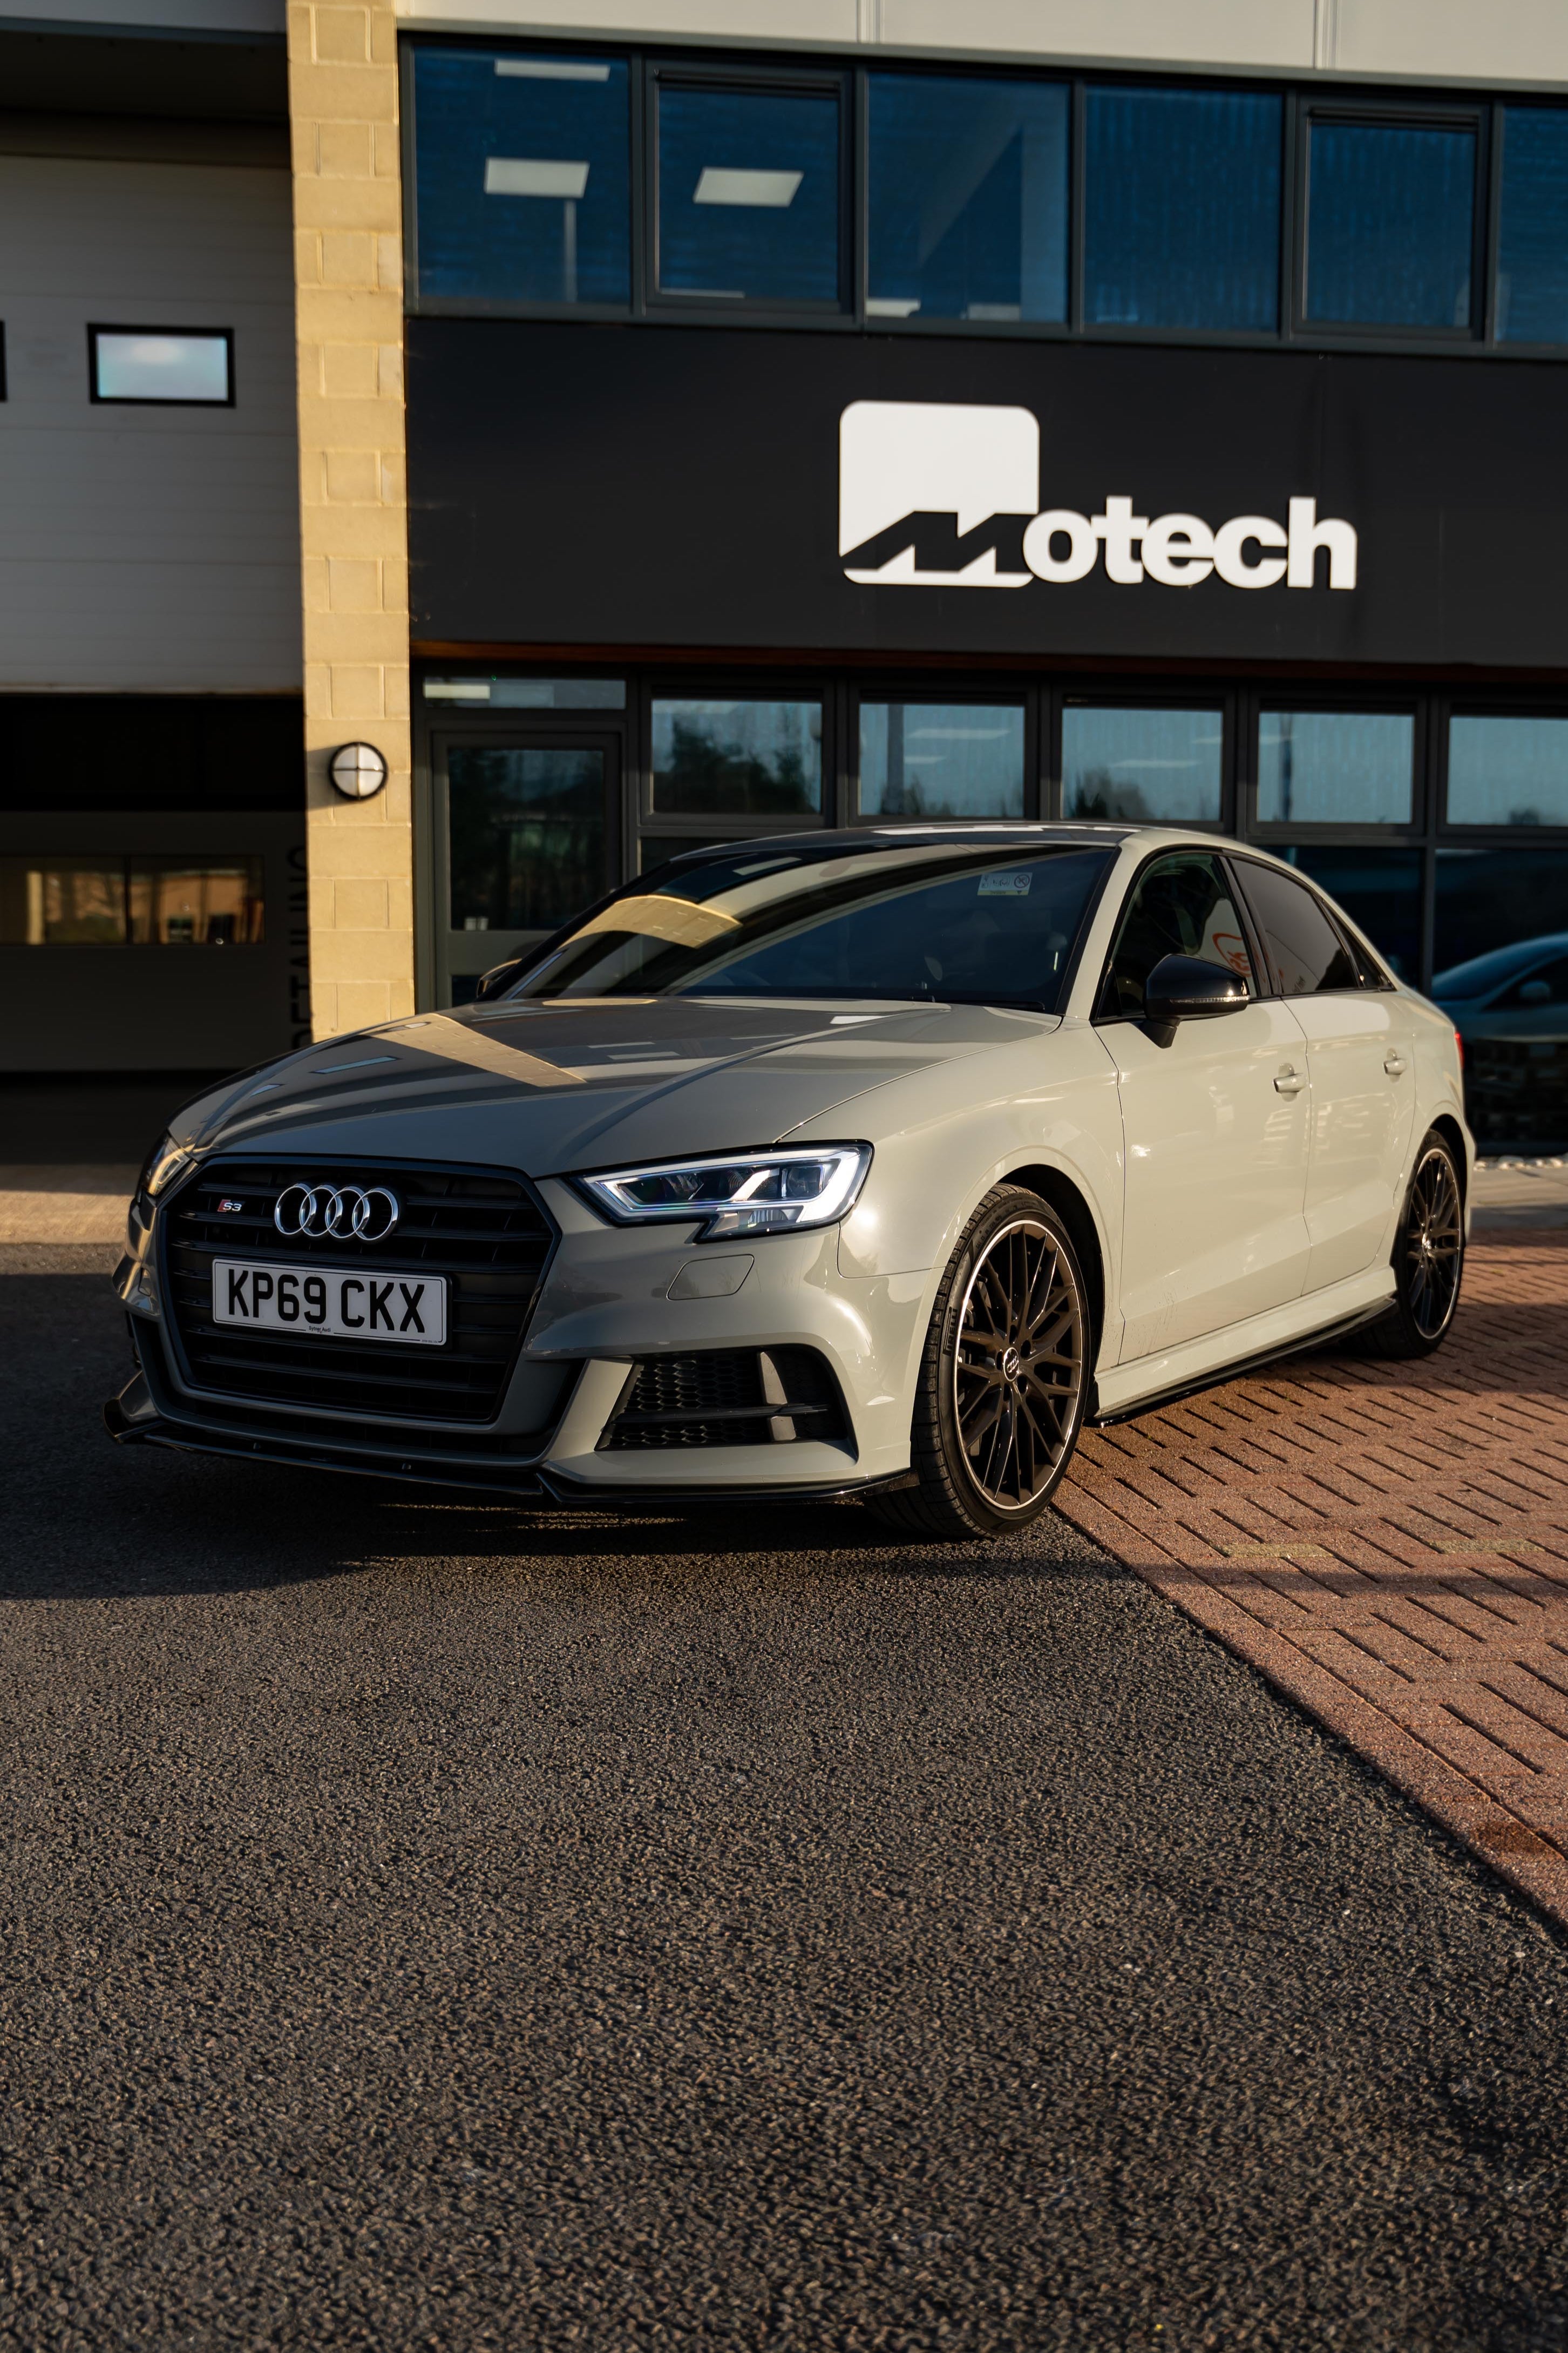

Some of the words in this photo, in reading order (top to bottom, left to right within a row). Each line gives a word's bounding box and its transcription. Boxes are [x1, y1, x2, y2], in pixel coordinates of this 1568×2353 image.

[222, 1202, 242, 1212] S3
[228, 1268, 327, 1324] KP69
[340, 1279, 425, 1333] CKX
[942, 1307, 958, 1356] PIRELLI
